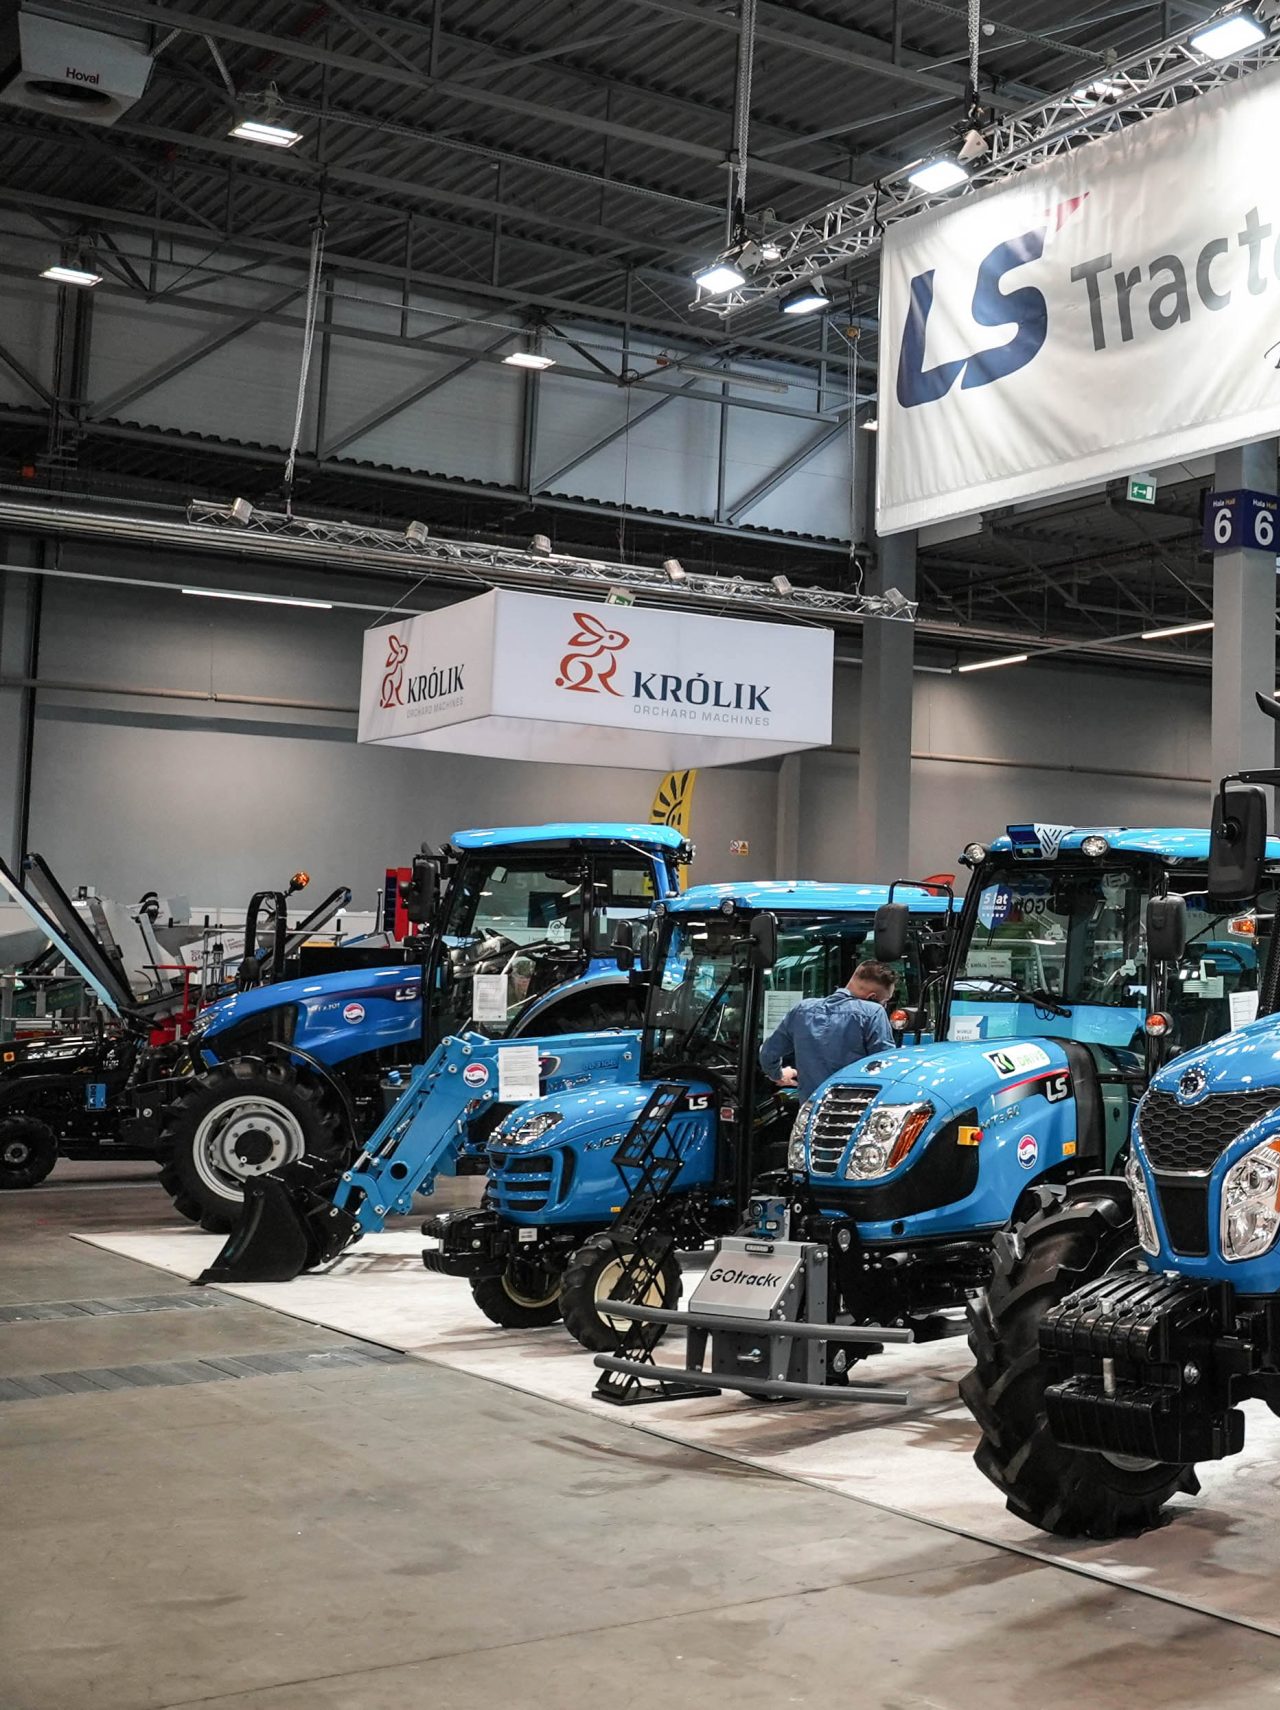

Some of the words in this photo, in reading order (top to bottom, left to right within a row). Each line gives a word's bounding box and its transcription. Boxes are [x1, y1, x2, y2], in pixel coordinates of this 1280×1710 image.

[65, 67, 100, 85] Hoval
[896, 226, 1048, 409] LS
[1253, 499, 1266, 508] Hala
[1214, 508, 1232, 544] 6
[1254, 510, 1274, 546] 6
[407, 664, 465, 704] KRÓLIK
[632, 671, 772, 712] KRÓLIK
[633, 704, 697, 720] ORCHARD
[701, 711, 770, 727] MACHINES
[992, 892, 1008, 905] lat
[395, 987, 417, 1001] LS
[1045, 1077, 1068, 1102] LS
[688, 1097, 709, 1110] LS
[709, 1268, 780, 1288] GOtrack
